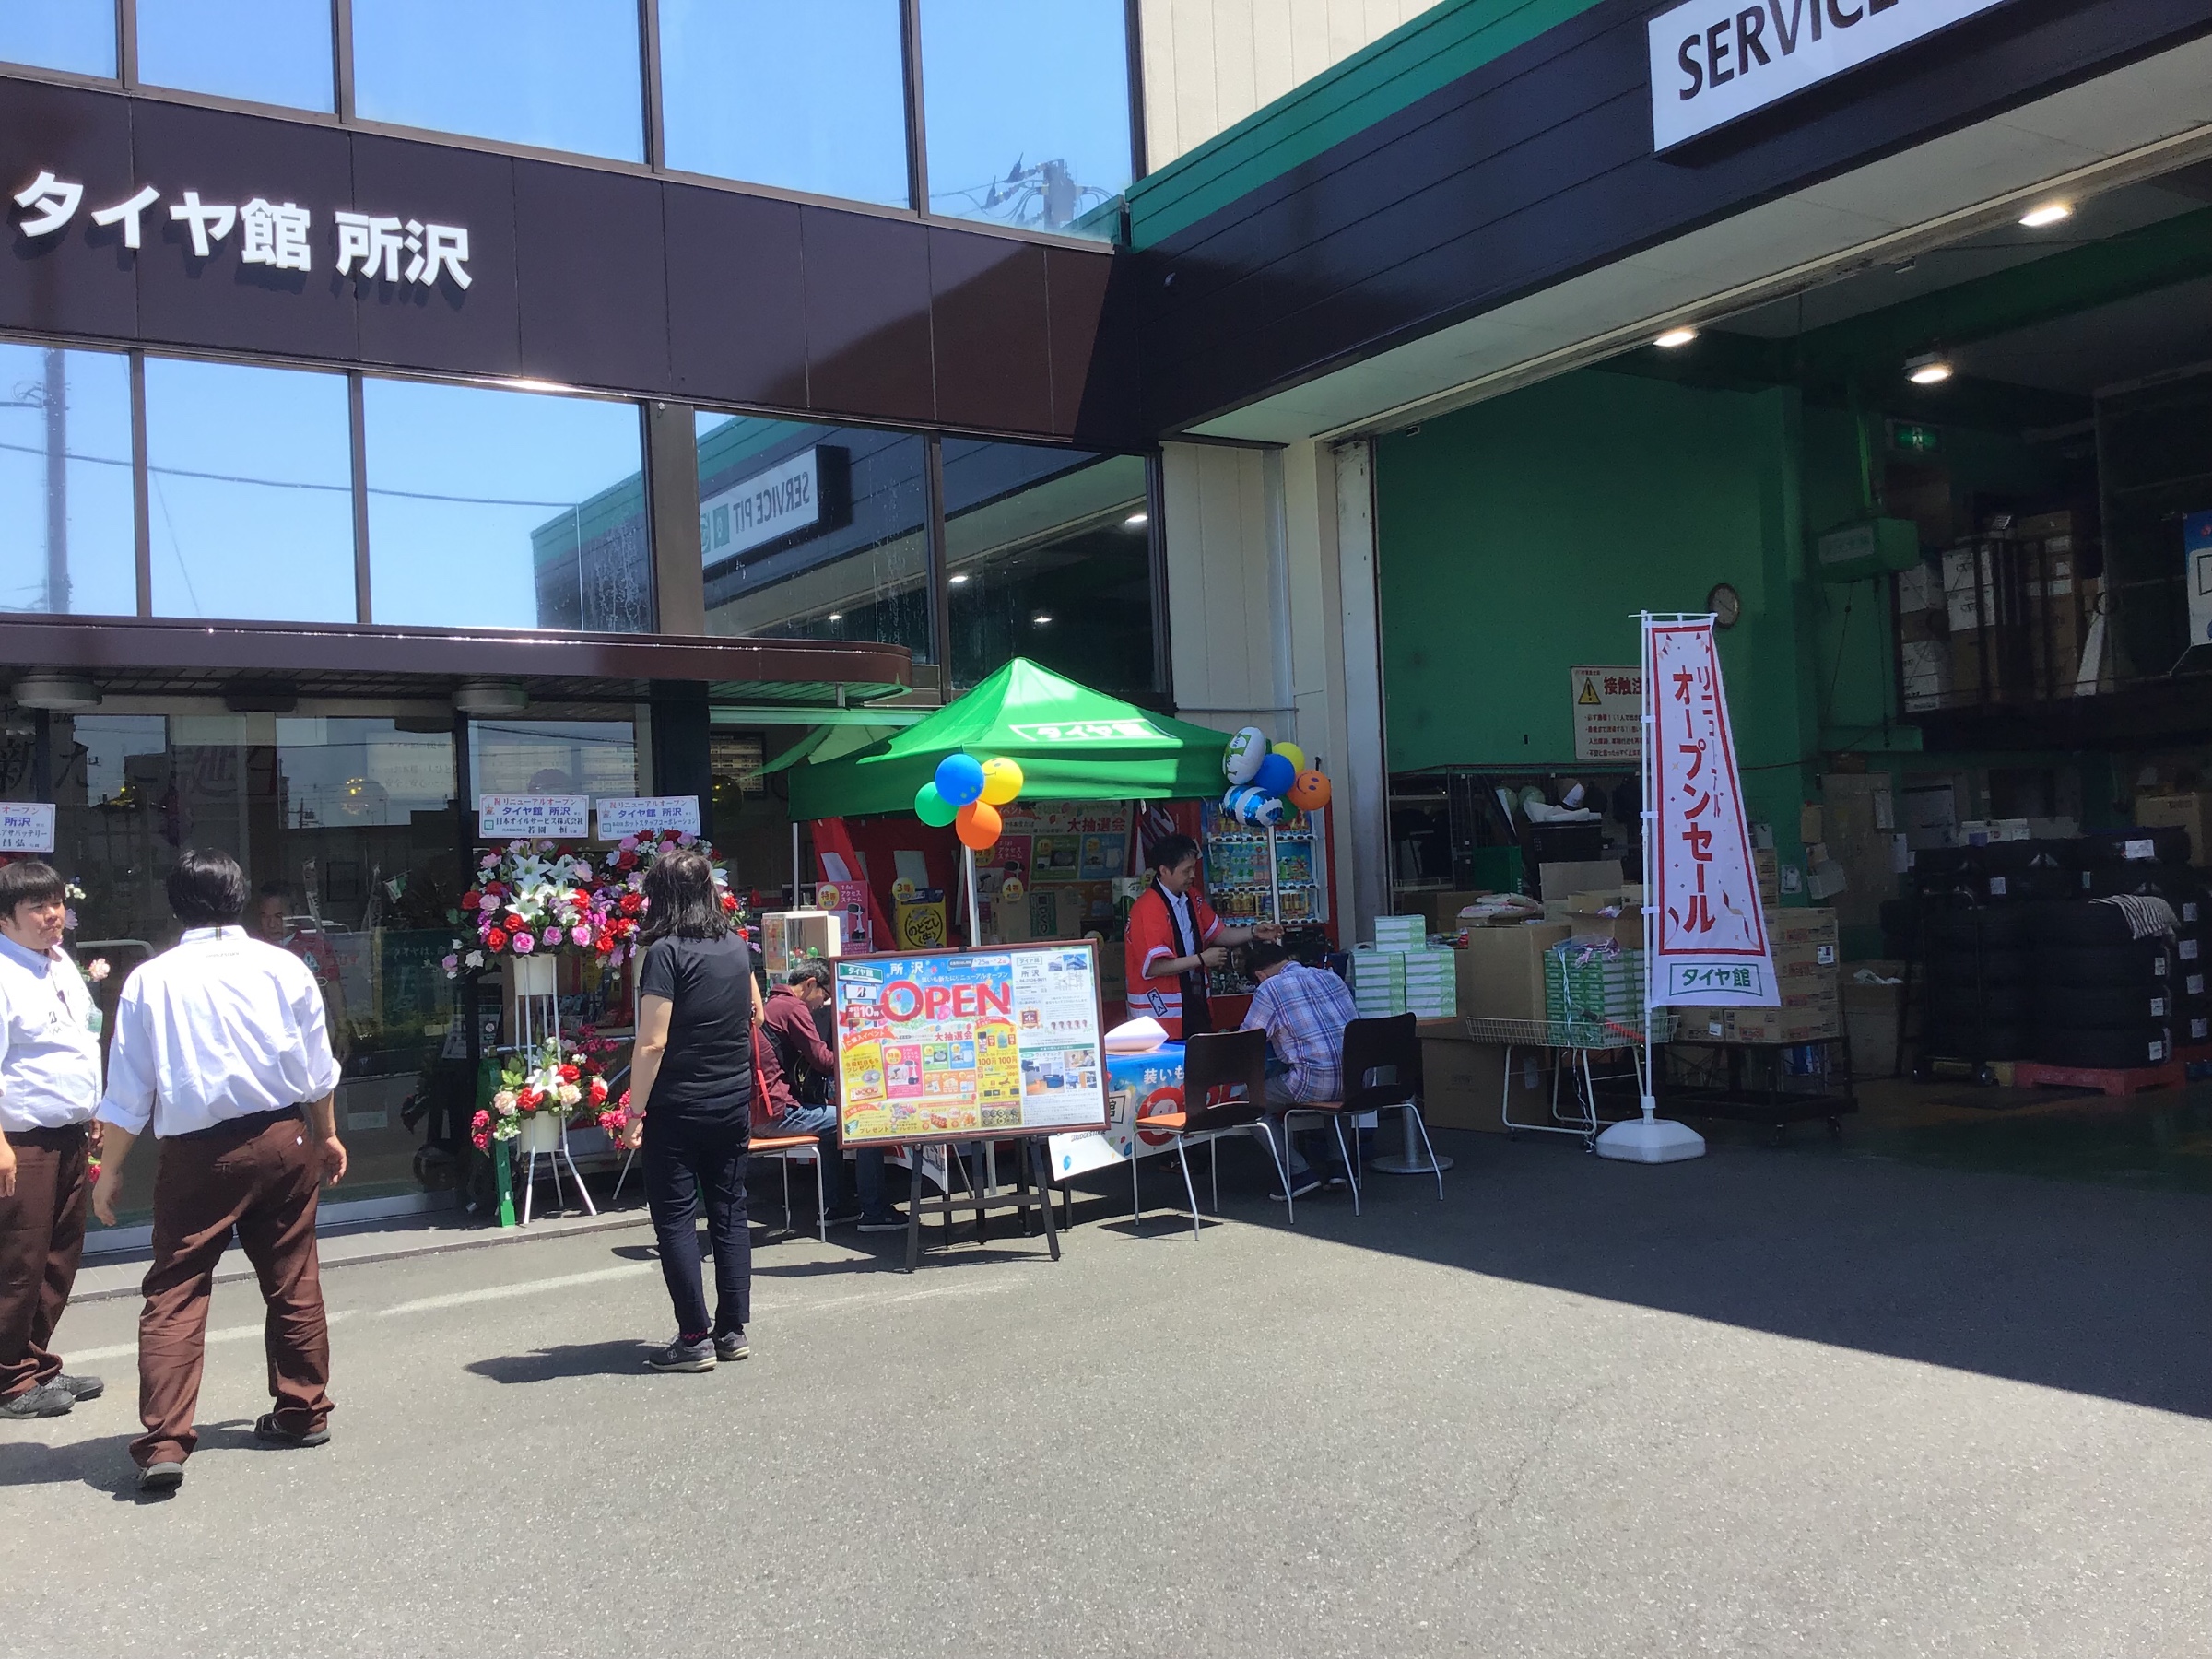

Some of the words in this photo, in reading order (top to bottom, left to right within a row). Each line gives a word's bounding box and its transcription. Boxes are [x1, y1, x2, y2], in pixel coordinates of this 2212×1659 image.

[13, 171, 312, 272] タイヤ館
[334, 211, 473, 291] 所沢
[503, 797, 577, 806] リニューアルオープン
[618, 800, 688, 808] リニューアルオープン
[1672, 665, 1717, 935] オープンセール
[502, 806, 543, 816] タイヤ館
[549, 806, 571, 816] 所沢
[618, 809, 657, 818] タイヤ館
[662, 807, 682, 817] 所沢
[4, 816, 32, 827] 所沢
[496, 818, 583, 826] 日本オイルサービス株式会社
[1067, 817, 1126, 833] 大抽選会
[0, 829, 48, 838] アサバッテリー
[889, 961, 924, 976] 所沢
[1681, 967, 1751, 987] タイヤ館
[879, 980, 1012, 1022] OPEN
[935, 1030, 973, 1042] 大抽選会
[1143, 1065, 1184, 1085] 装いも
